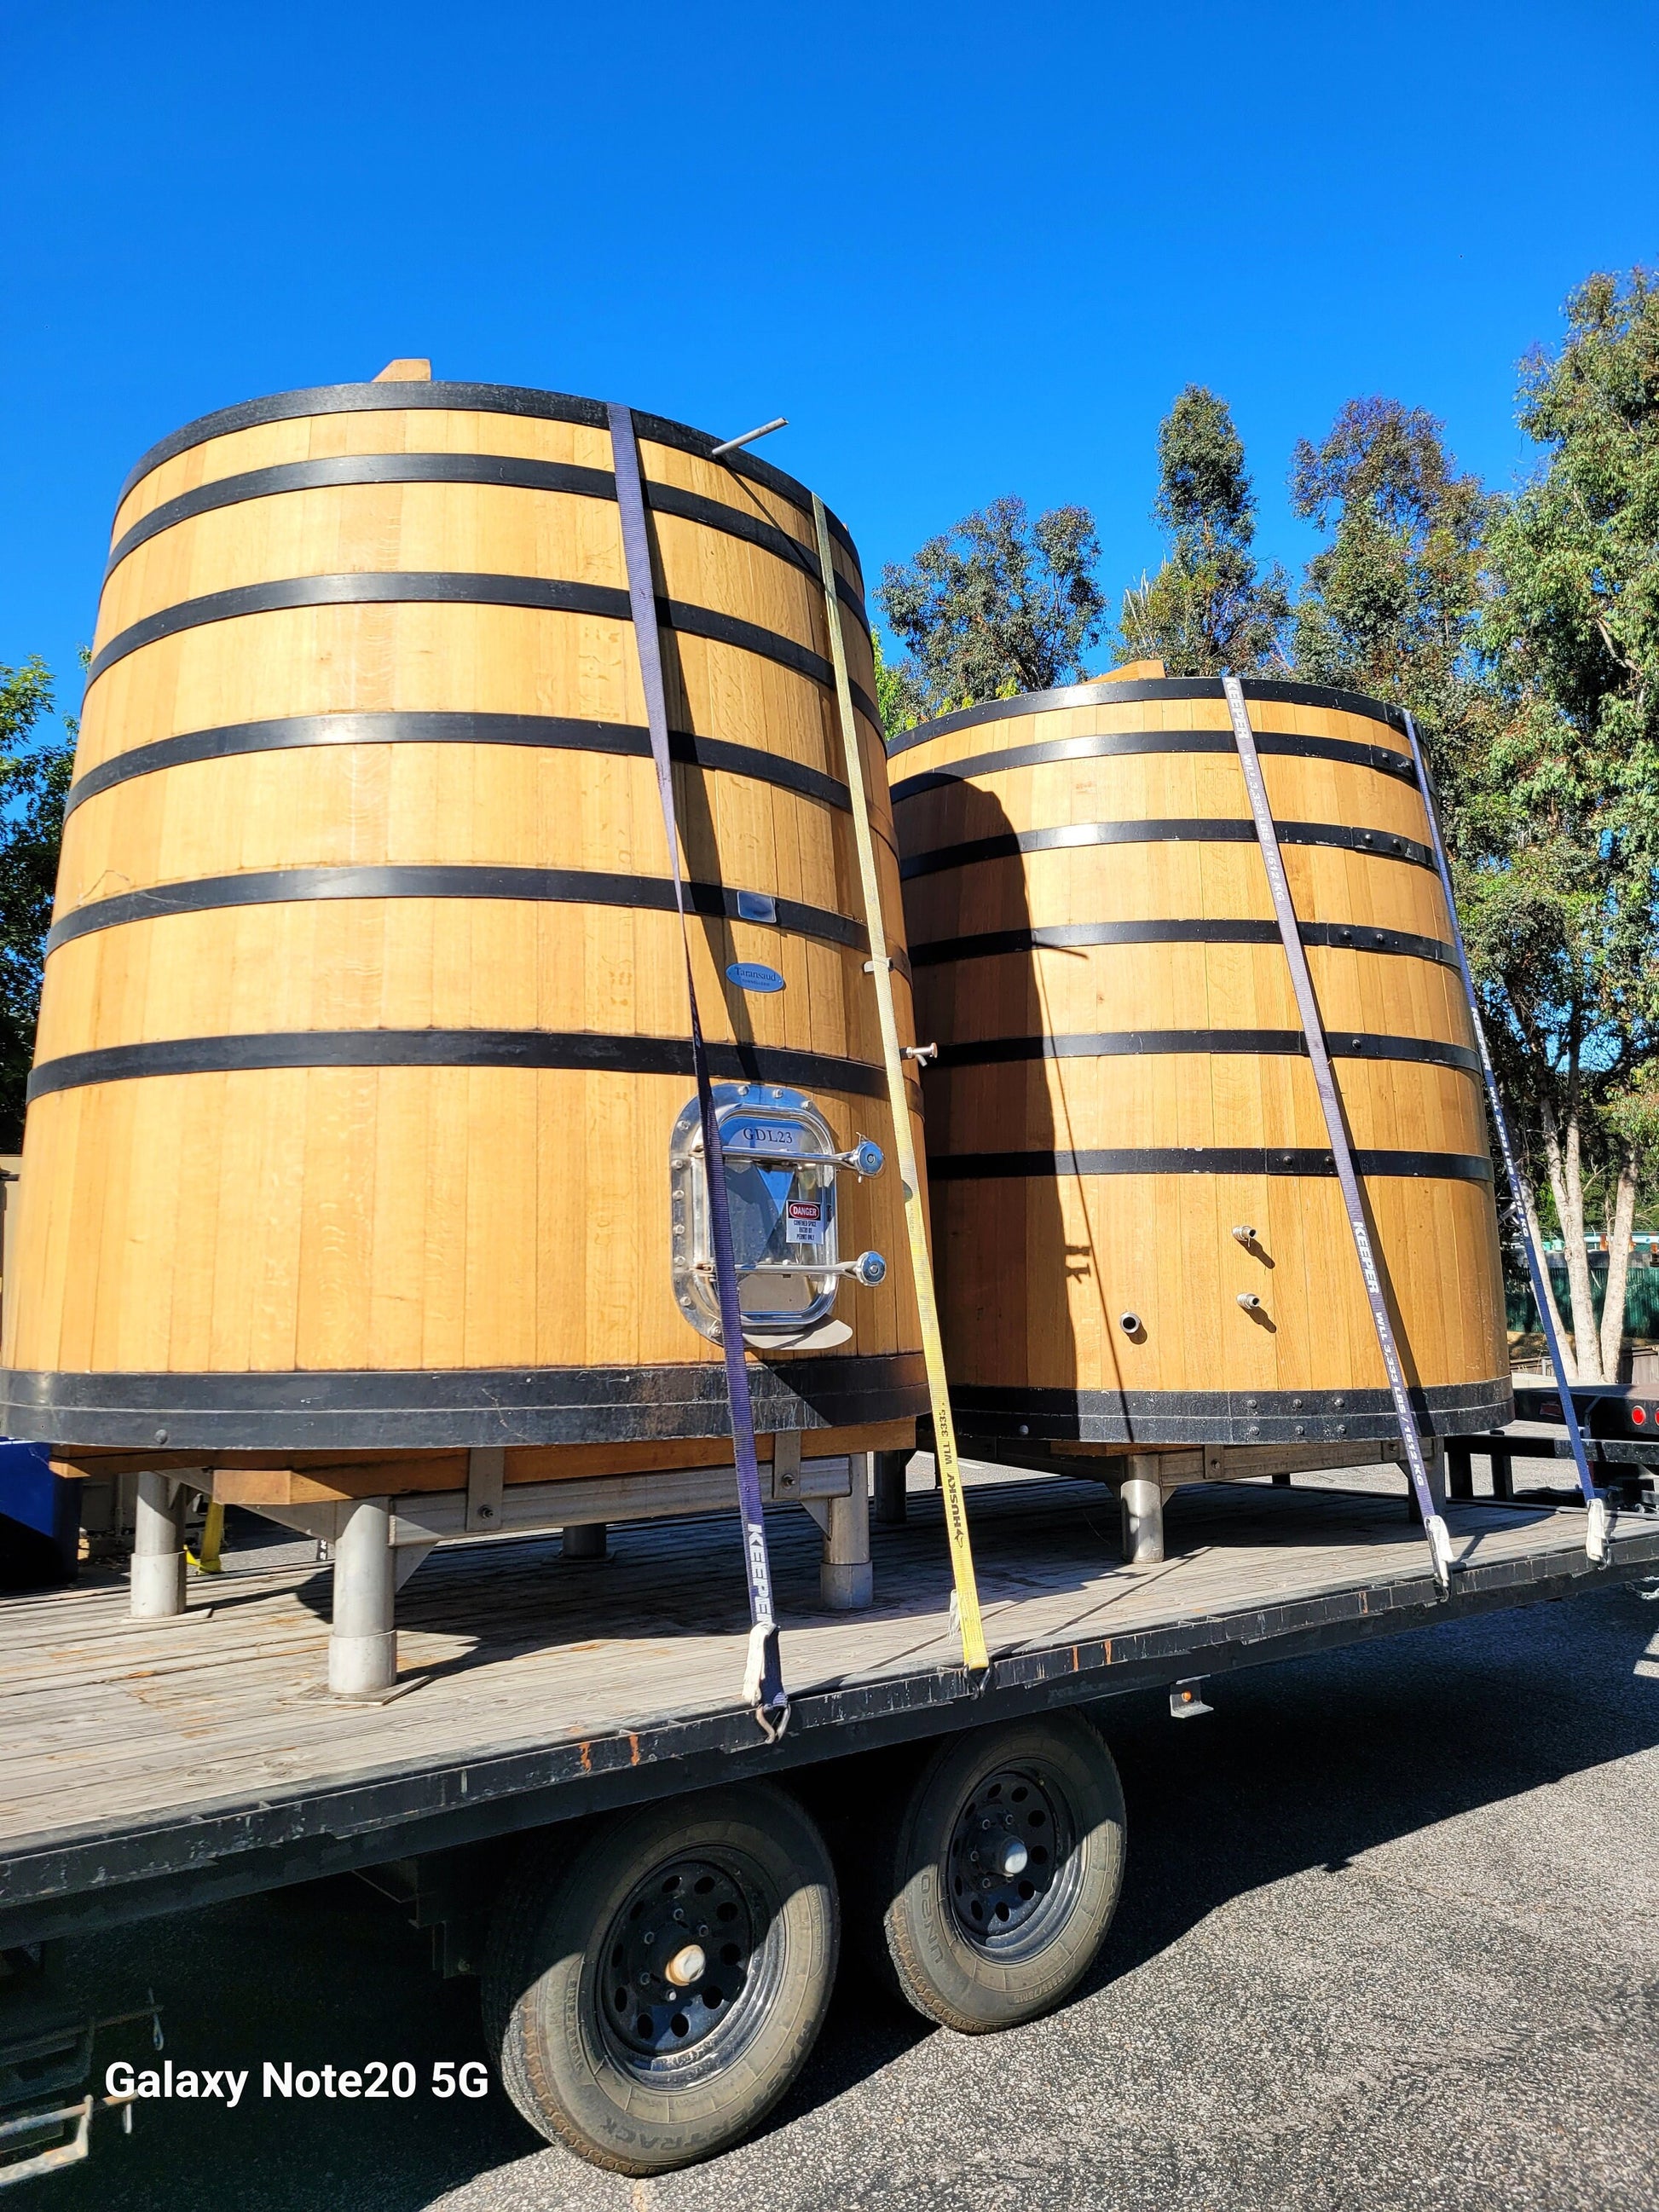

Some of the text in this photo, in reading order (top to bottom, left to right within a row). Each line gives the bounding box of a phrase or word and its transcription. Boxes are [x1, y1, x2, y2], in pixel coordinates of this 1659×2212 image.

[1225, 676, 1250, 739] KEEPER
[1244, 754, 1256, 779] WLL
[1258, 817, 1270, 840] LBS
[735, 967, 777, 982] Taransaud
[1471, 1007, 1491, 1071] KEEPER
[743, 1126, 794, 1145] GDL23
[793, 1206, 817, 1216] DANGER
[1352, 1221, 1379, 1294] KEEPER
[1376, 1312, 1388, 1341] WLL
[1384, 1344, 1398, 1383] 3,333
[1393, 1386, 1407, 1414] LBS
[1405, 1425, 1418, 1460] 1512
[1414, 1464, 1425, 1487] KG
[943, 1441, 952, 1464] WLL
[946, 1473, 962, 1528] HUSKY
